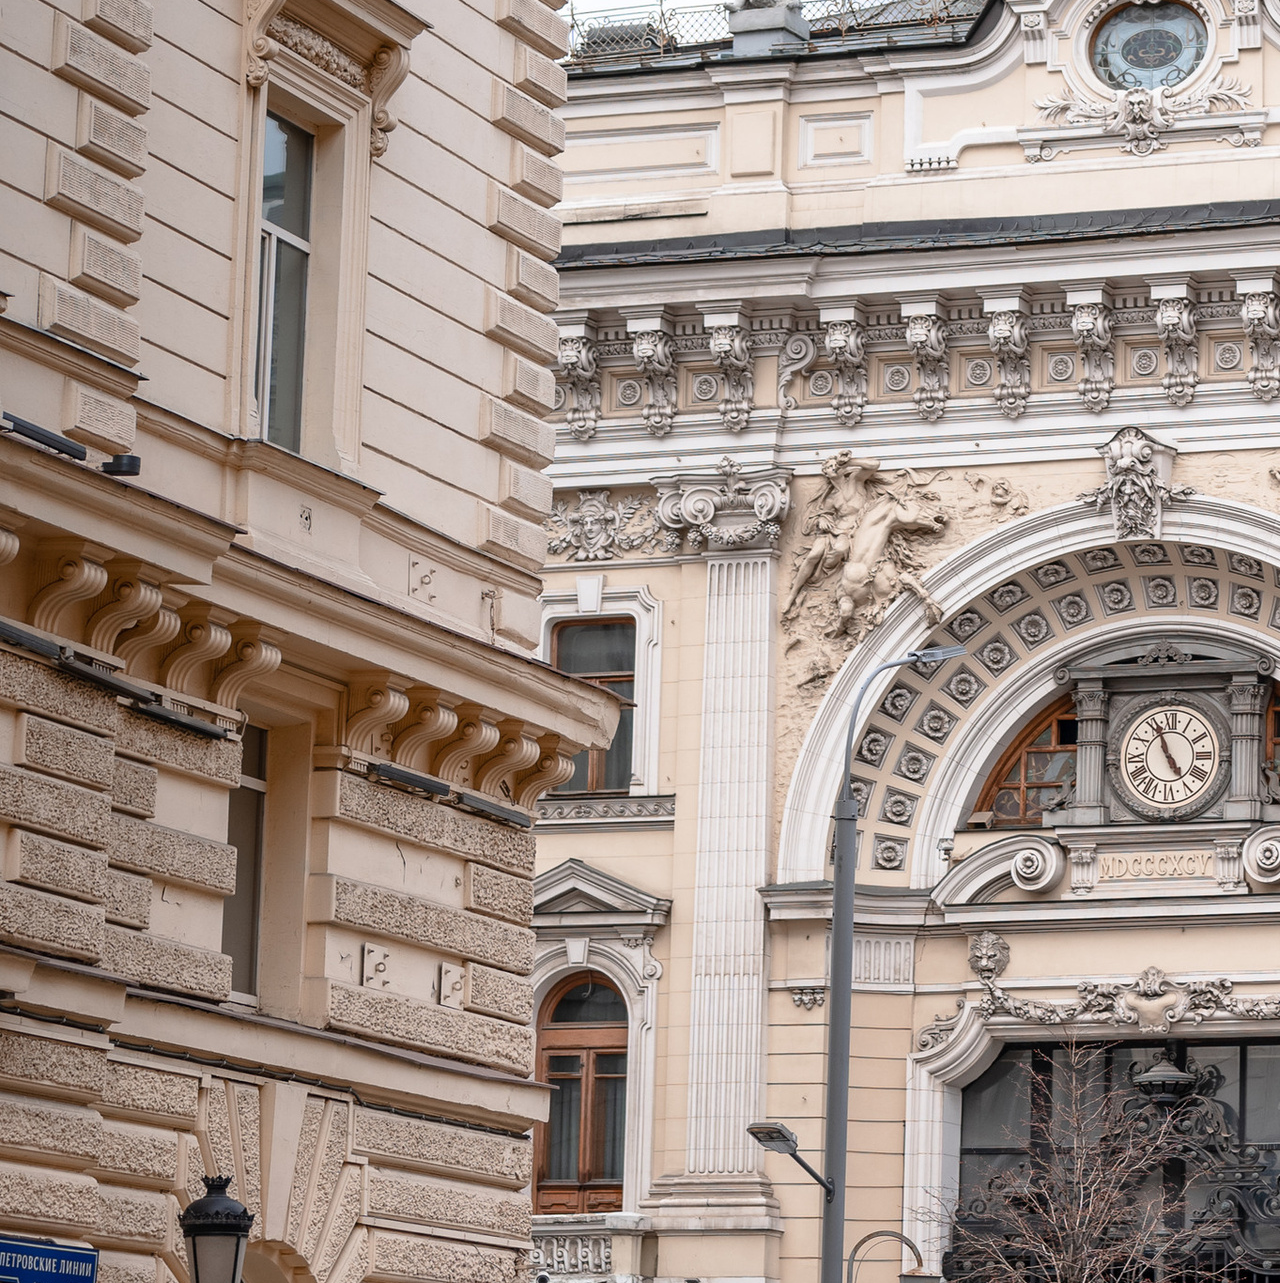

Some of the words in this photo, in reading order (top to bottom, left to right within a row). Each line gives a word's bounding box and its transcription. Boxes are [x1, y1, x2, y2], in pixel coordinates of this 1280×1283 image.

[1164, 713, 1177, 730] XII
[1132, 733, 1149, 747] X
[1191, 731, 1208, 745] II
[1128, 752, 1144, 763] IX
[1195, 751, 1211, 760] III
[1163, 783, 1175, 801] VI
[1182, 780, 1193, 796] V
[1099, 854, 1213, 878] MDCCCXCV
[0, 1252, 57, 1273] ПЕТРОВСКИЕ
[59, 1259, 92, 1277] ЛИНИИ
